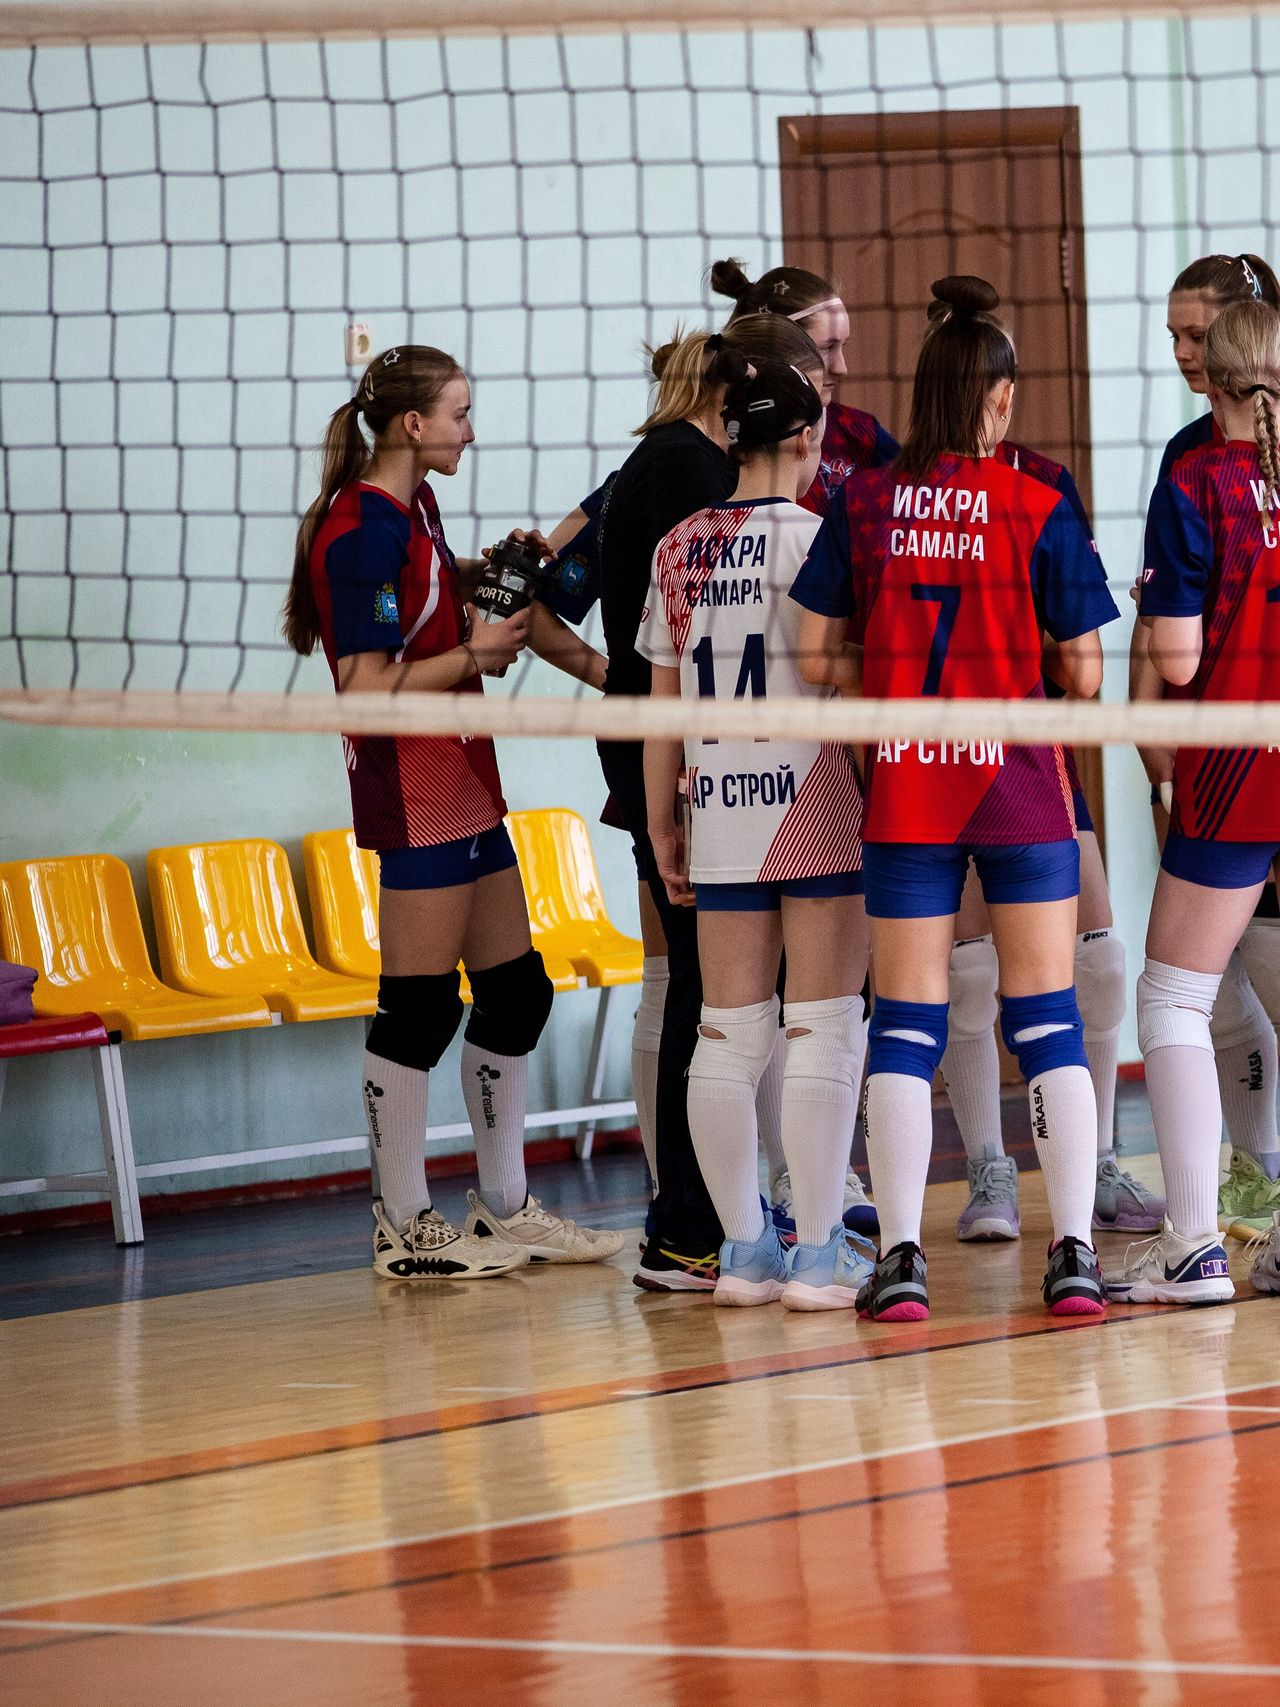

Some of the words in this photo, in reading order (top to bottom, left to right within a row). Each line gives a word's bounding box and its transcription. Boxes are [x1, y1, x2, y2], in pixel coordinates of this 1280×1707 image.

[892, 484, 988, 524] ИСКРА
[687, 535, 766, 570] ИСКРА
[891, 529, 985, 561] САМАРА
[474, 585, 513, 605] PORTS
[685, 577, 763, 608] САМАРА
[911, 583, 961, 696] 7
[692, 633, 770, 745] 14
[721, 764, 797, 808] СТРОЙ
[1248, 1049, 1262, 1090] MIKASA
[1033, 1084, 1049, 1139] MIKASA
[1201, 1258, 1229, 1279] NIK
